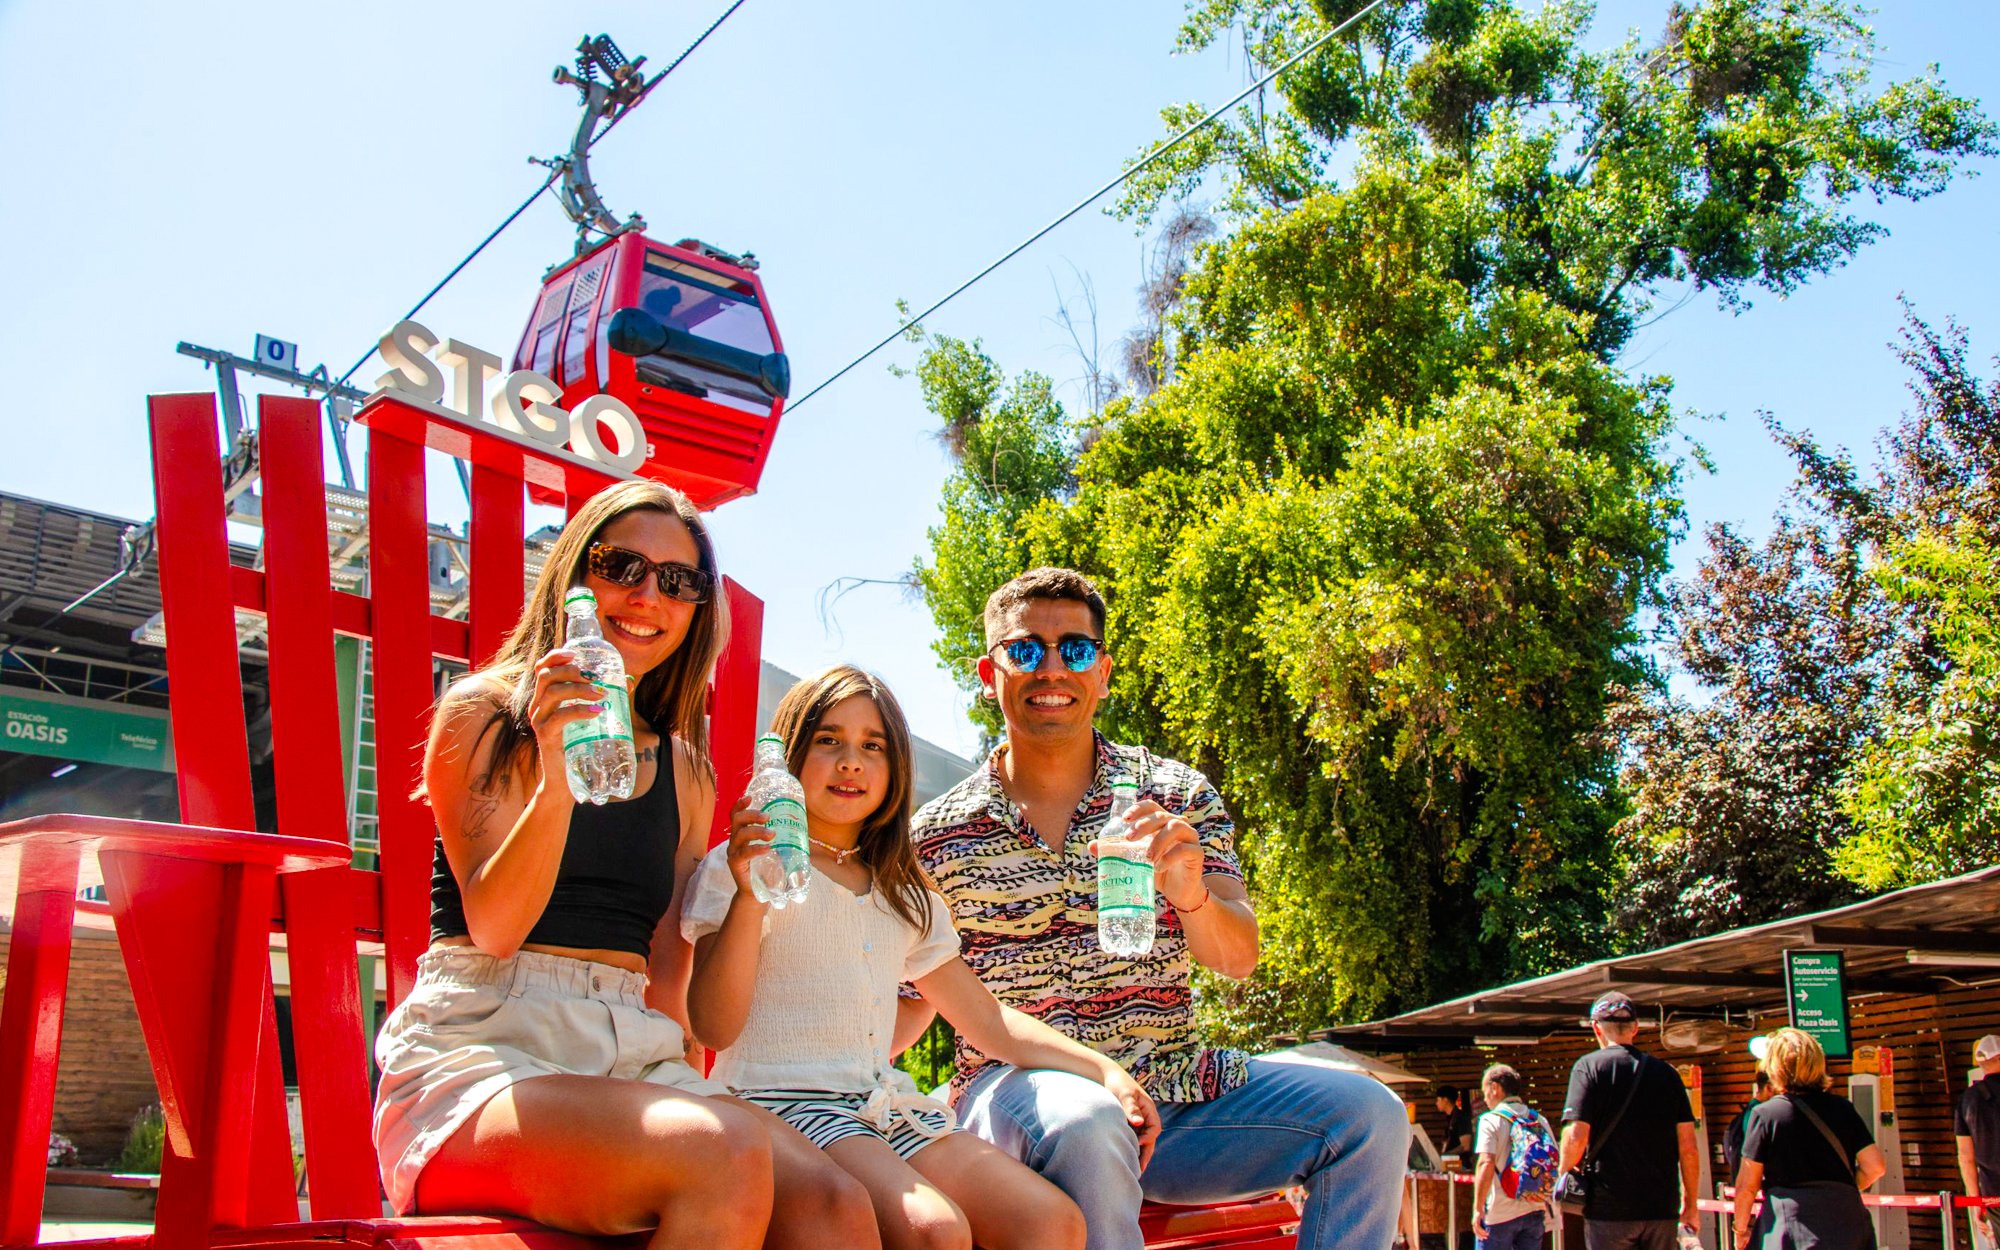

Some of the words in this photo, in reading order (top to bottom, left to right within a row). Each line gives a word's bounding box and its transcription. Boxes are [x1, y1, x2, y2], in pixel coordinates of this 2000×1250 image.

[374, 320, 648, 473] STGO
[8, 710, 48, 723] ESTACIÓN
[6, 720, 69, 745] OASIS
[1793, 956, 1821, 966] Compra
[1794, 967, 1839, 975] Autoservicio
[1797, 1008, 1823, 1016] Acceso
[1798, 1018, 1818, 1027] Plaza
[1818, 1018, 1839, 1027] Oasis
